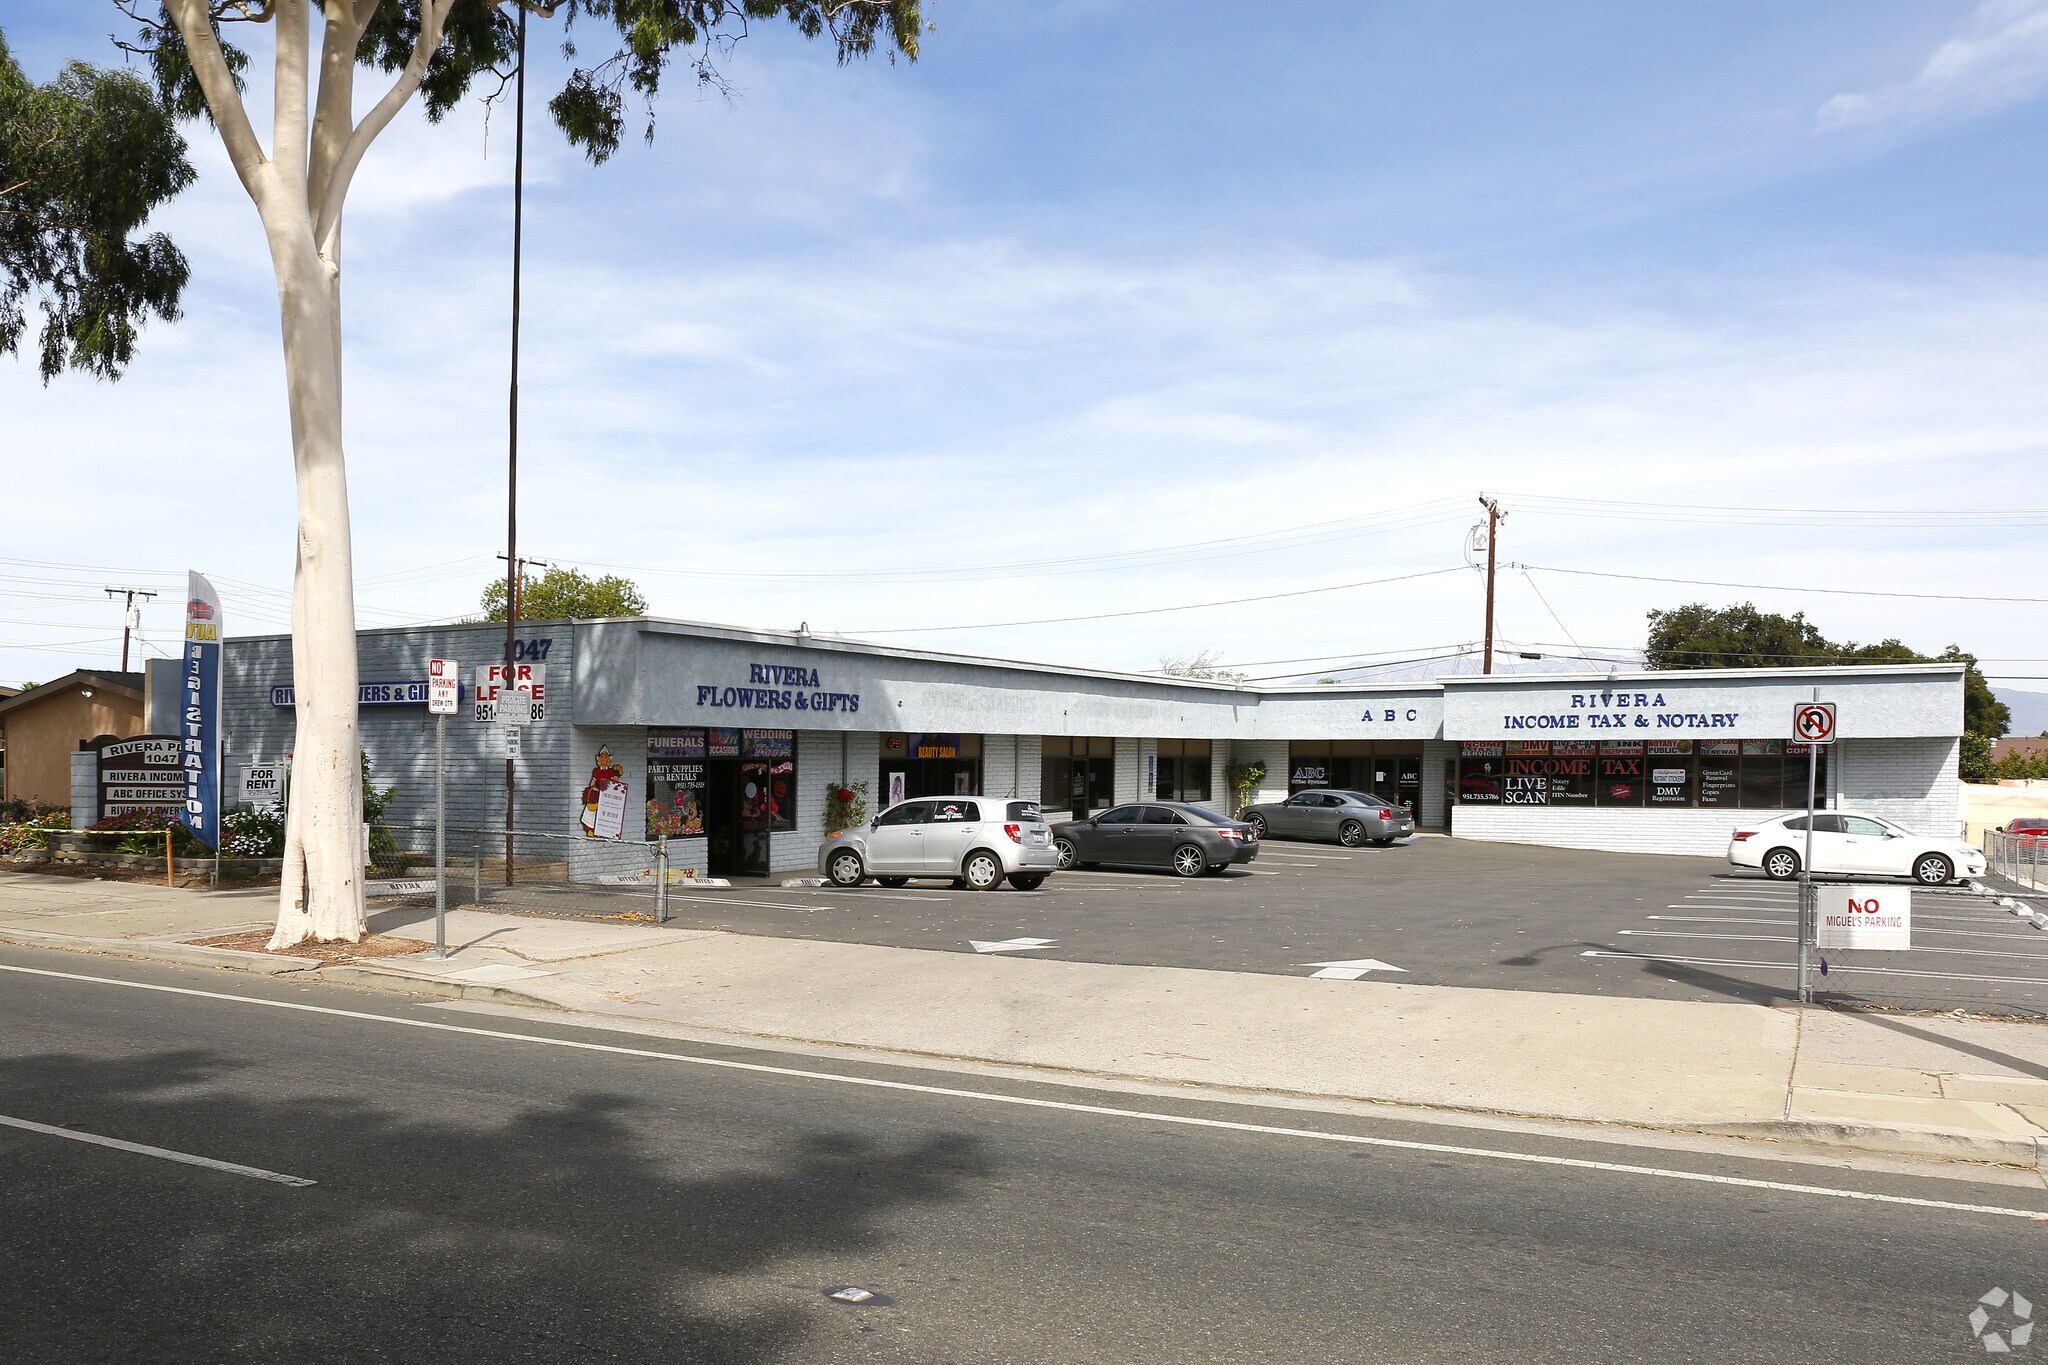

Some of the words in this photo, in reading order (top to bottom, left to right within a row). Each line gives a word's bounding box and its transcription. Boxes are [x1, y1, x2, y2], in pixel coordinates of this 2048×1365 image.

[431, 661, 442, 674] NO
[489, 665, 532, 681] FOR
[749, 663, 820, 688] RIVERA
[431, 678, 456, 689] PARKING
[275, 689, 296, 704] RIV
[393, 687, 404, 701] &
[407, 684, 430, 701] GIF
[437, 690, 449, 698] ANY
[476, 684, 545, 701] LEE
[697, 685, 792, 710] FLOWERS
[794, 691, 809, 710] &
[810, 691, 860, 713] GIFTS
[1571, 693, 1667, 708] RIVERA
[1503, 715, 1580, 729] INCOME
[1588, 714, 1627, 728] TAX
[1634, 714, 1650, 727] &
[1656, 713, 1739, 728] NOTARY
[743, 729, 793, 740] WEDDING
[647, 737, 705, 748] FUNERALS
[1522, 740, 1547, 750] DMV
[1574, 740, 1595, 748] SCAN
[109, 743, 162, 756] RIVERA
[918, 747, 938, 758] BEAUTY
[939, 747, 956, 758] SALON
[145, 754, 178, 763] 1047
[648, 765, 670, 773] PARTY
[672, 765, 703, 773] SUPPLIES
[1509, 759, 1590, 775] INCOME
[1602, 759, 1640, 775] TAX
[109, 772, 147, 782] RIVERA
[149, 773, 184, 782] INCOM
[251, 769, 273, 779] FOR
[666, 773, 697, 781] RENTALS
[1293, 767, 1325, 779] ABC
[246, 779, 276, 790] RENT
[1505, 778, 1547, 789] LIVE
[113, 789, 133, 798] ABC
[136, 789, 167, 798] OFFICE
[1657, 787, 1681, 796] DMV
[1505, 792, 1547, 804] SCAN
[1848, 899, 1880, 914] NO
[1826, 916, 1862, 927] MIGUEL'S
[1864, 916, 1902, 928] PARKING
